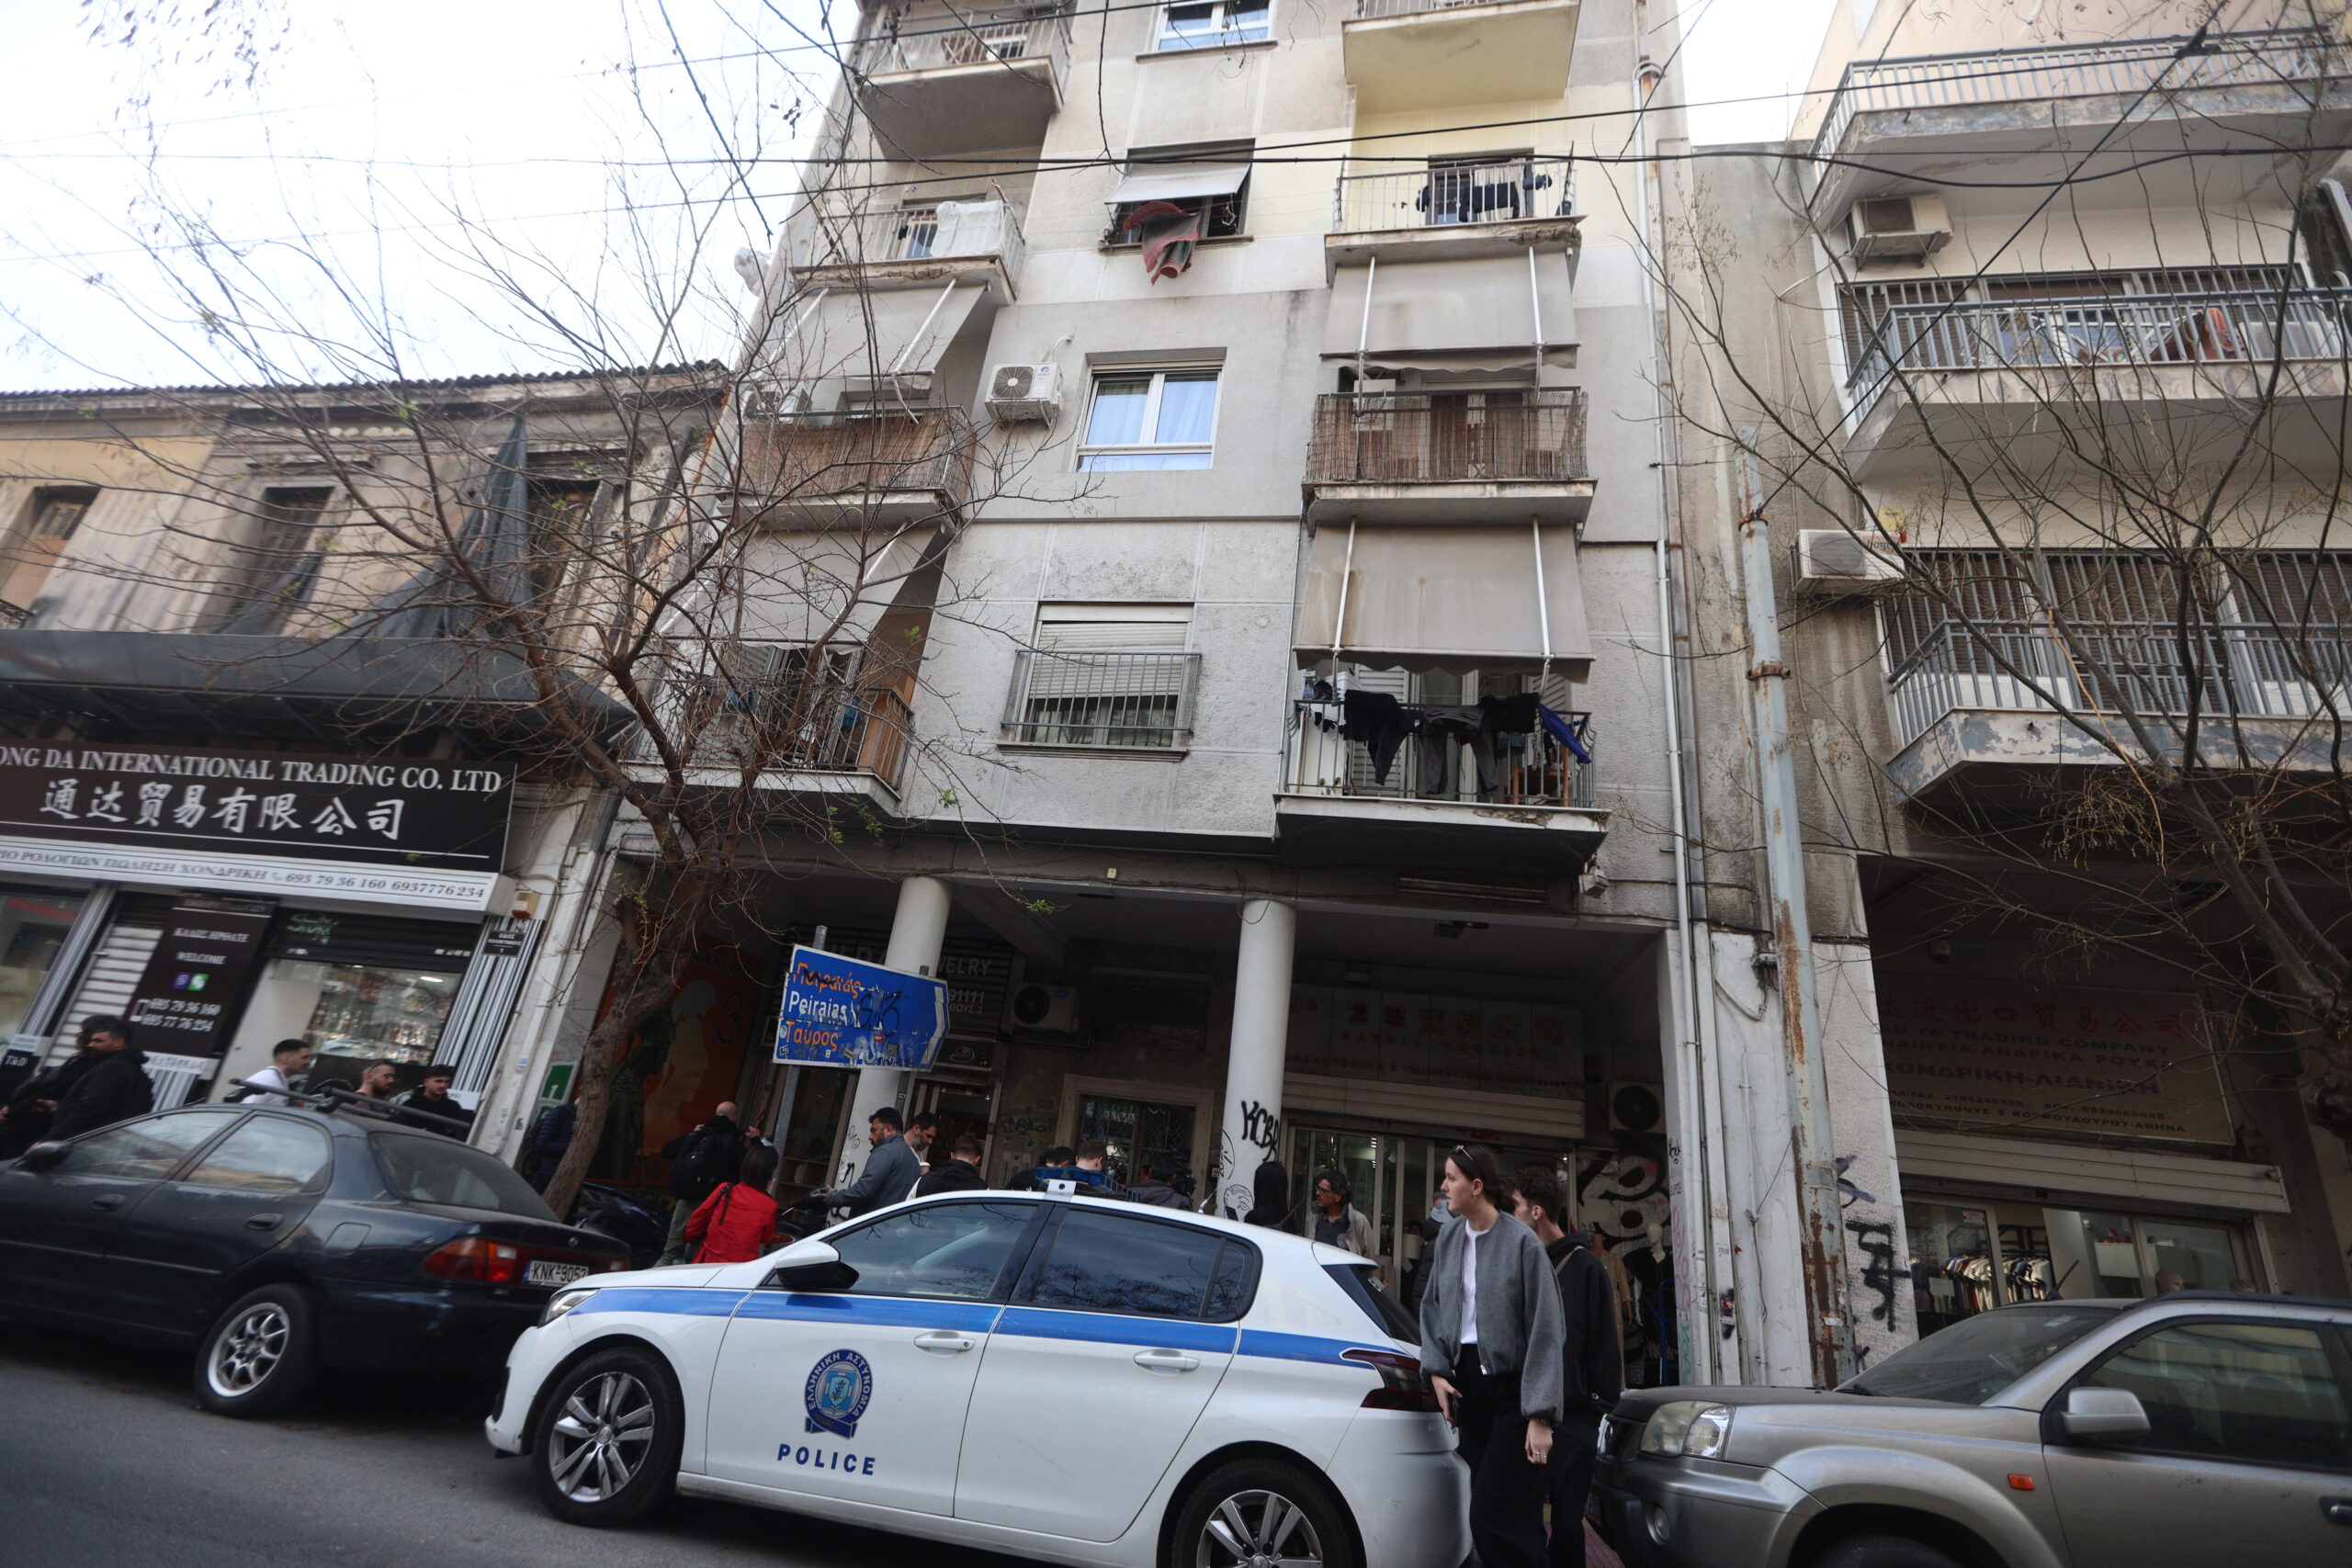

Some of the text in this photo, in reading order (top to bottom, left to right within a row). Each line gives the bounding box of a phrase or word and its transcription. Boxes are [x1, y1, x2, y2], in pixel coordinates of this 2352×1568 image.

[43, 749, 74, 770] DA
[79, 750, 275, 781] INTERNATIONAL
[280, 761, 396, 788] TRADING
[401, 767, 444, 790] CO.
[449, 769, 503, 793] LTD
[40, 778, 405, 840] 通达贸易有限公司
[178, 863, 269, 881] ΧΟΝΔΡΙΚΗ
[359, 878, 387, 890] 160
[787, 990, 847, 1022] Peiraias
[785, 1020, 839, 1052] Ταύρος
[1949, 1029, 2050, 1045] TRADING
[2058, 1037, 2169, 1055] COMPANY
[806, 1351, 872, 1416] ΕΛΛΗΝΙΚΗ ΑΣΤΥΝΟΜΙΑ
[777, 1442, 876, 1476] POLICE
